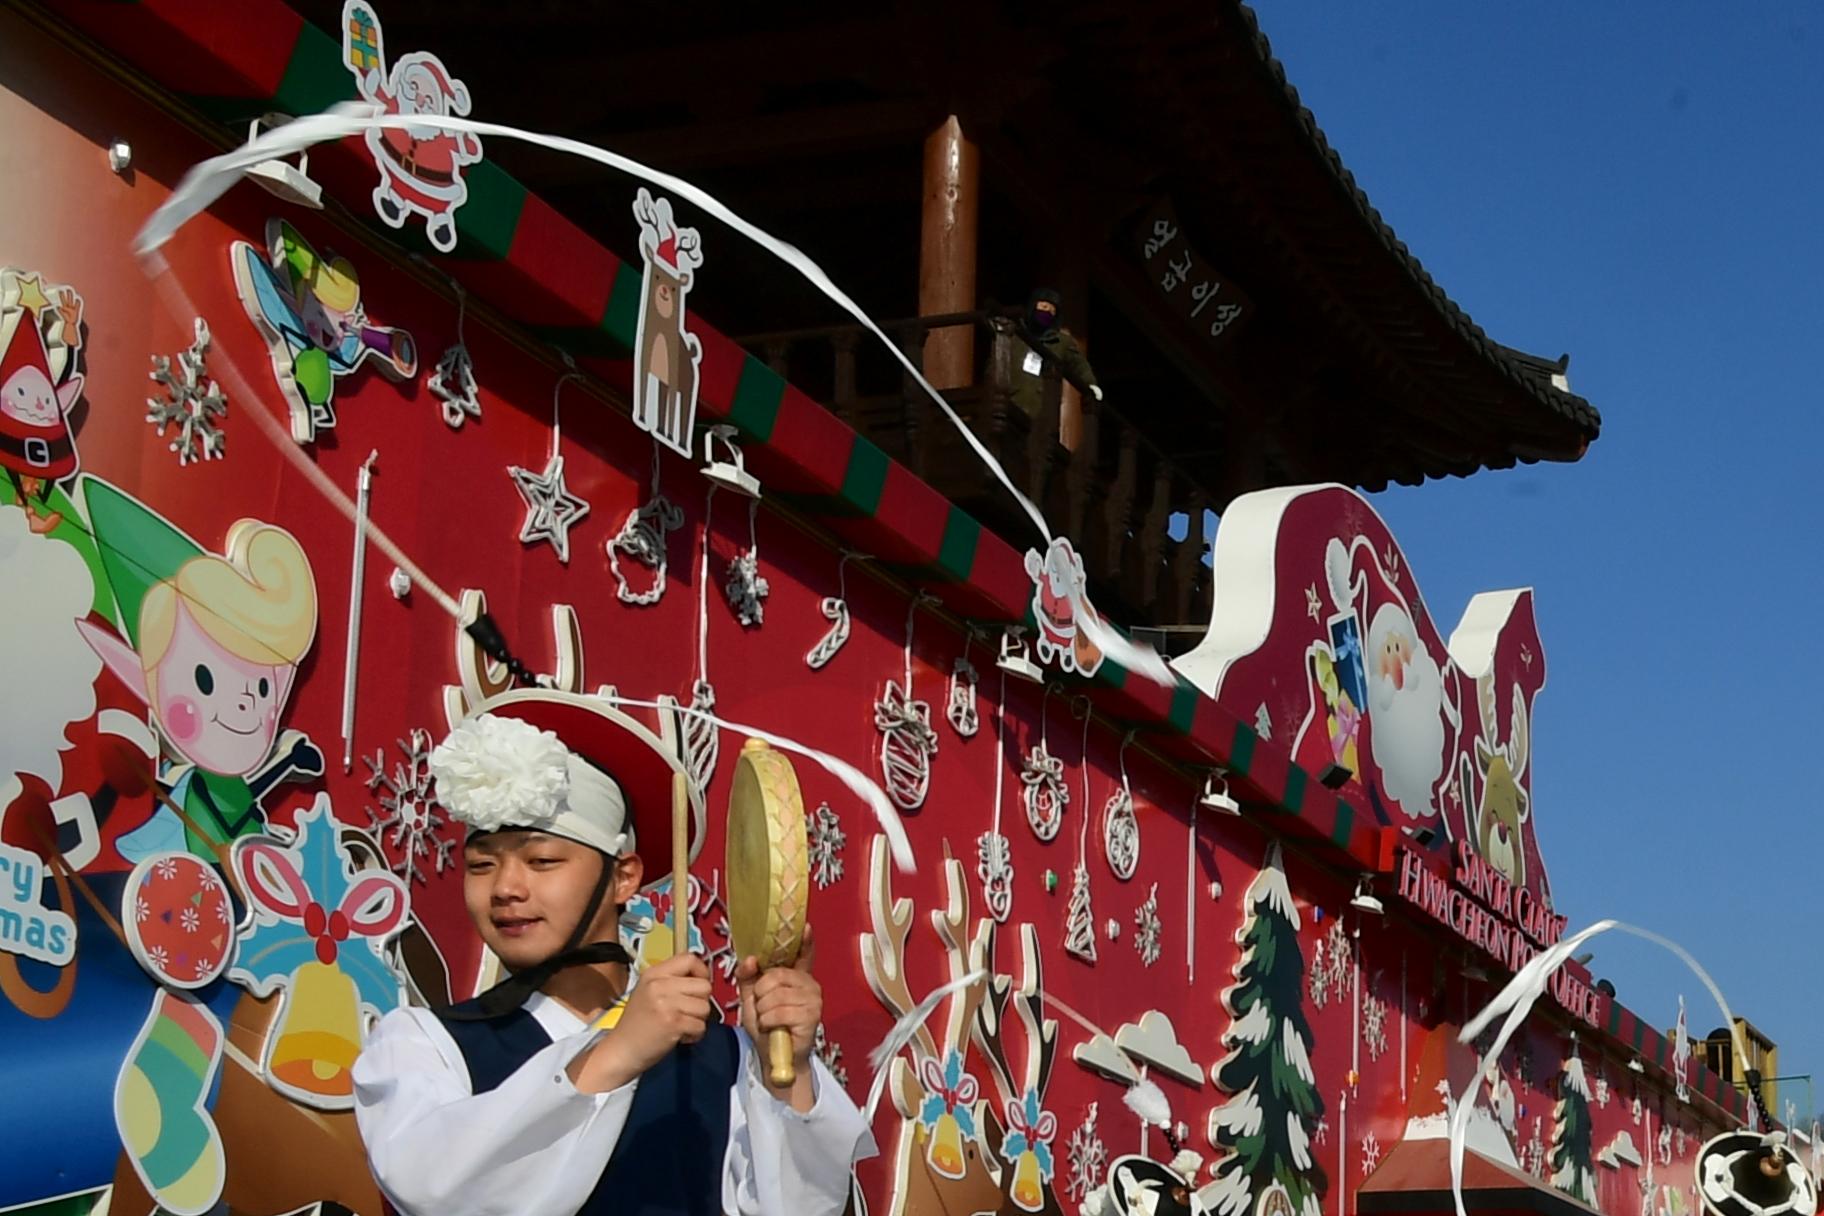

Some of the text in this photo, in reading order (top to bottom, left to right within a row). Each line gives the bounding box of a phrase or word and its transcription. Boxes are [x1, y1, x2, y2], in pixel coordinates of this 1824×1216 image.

[1144, 220, 1242, 336] 얼곰이성
[1399, 846, 1510, 965] HWACHEON
[1551, 964, 1601, 1028] OFFICE
[1456, 838, 1513, 920] SANTA
